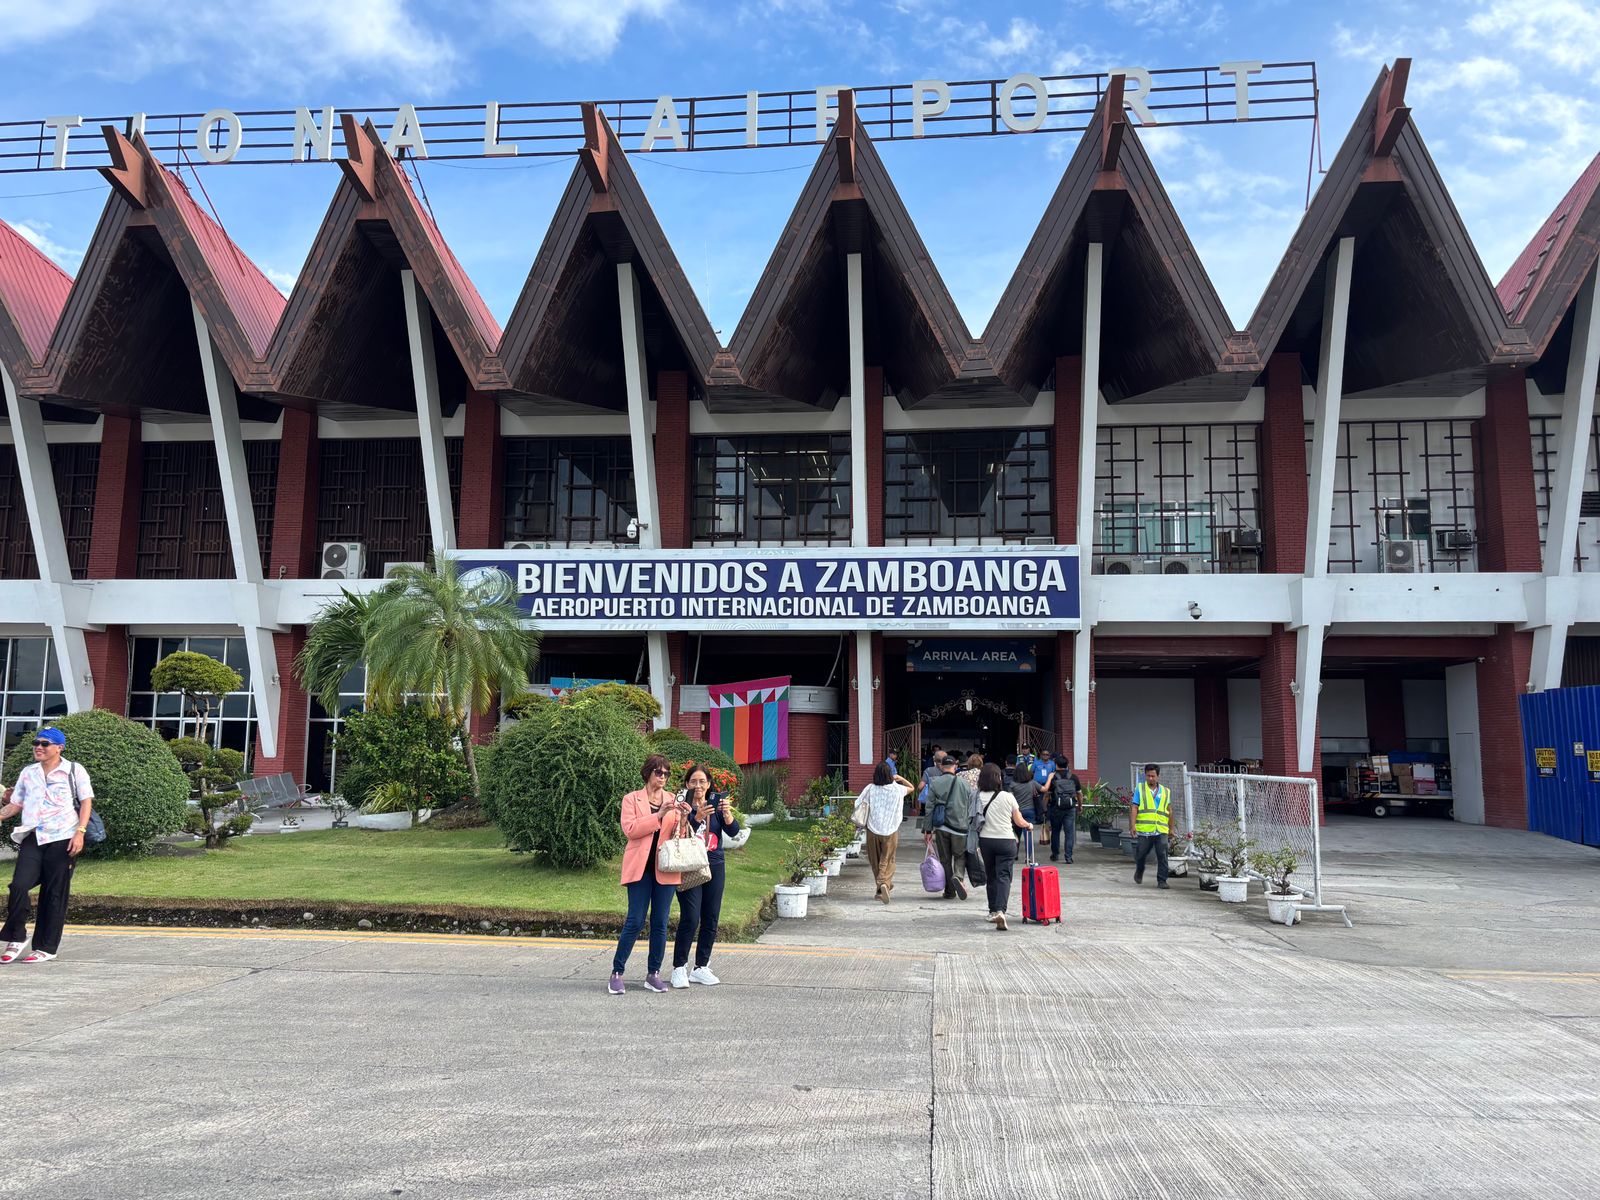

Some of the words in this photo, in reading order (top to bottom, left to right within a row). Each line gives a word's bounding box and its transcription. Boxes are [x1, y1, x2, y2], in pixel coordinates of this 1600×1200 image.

[517, 561, 768, 594] BIENVENIDOS
[778, 561, 804, 593] A
[815, 559, 1067, 593] ZAMBOANGA
[531, 597, 676, 617] AEROPUERTO
[682, 597, 860, 617] INTERNACIONAL
[867, 596, 895, 616] DE
[902, 595, 1051, 616] ZAMBOANGA
[922, 651, 978, 661] ARRIVAL
[981, 651, 1018, 661] AREA
